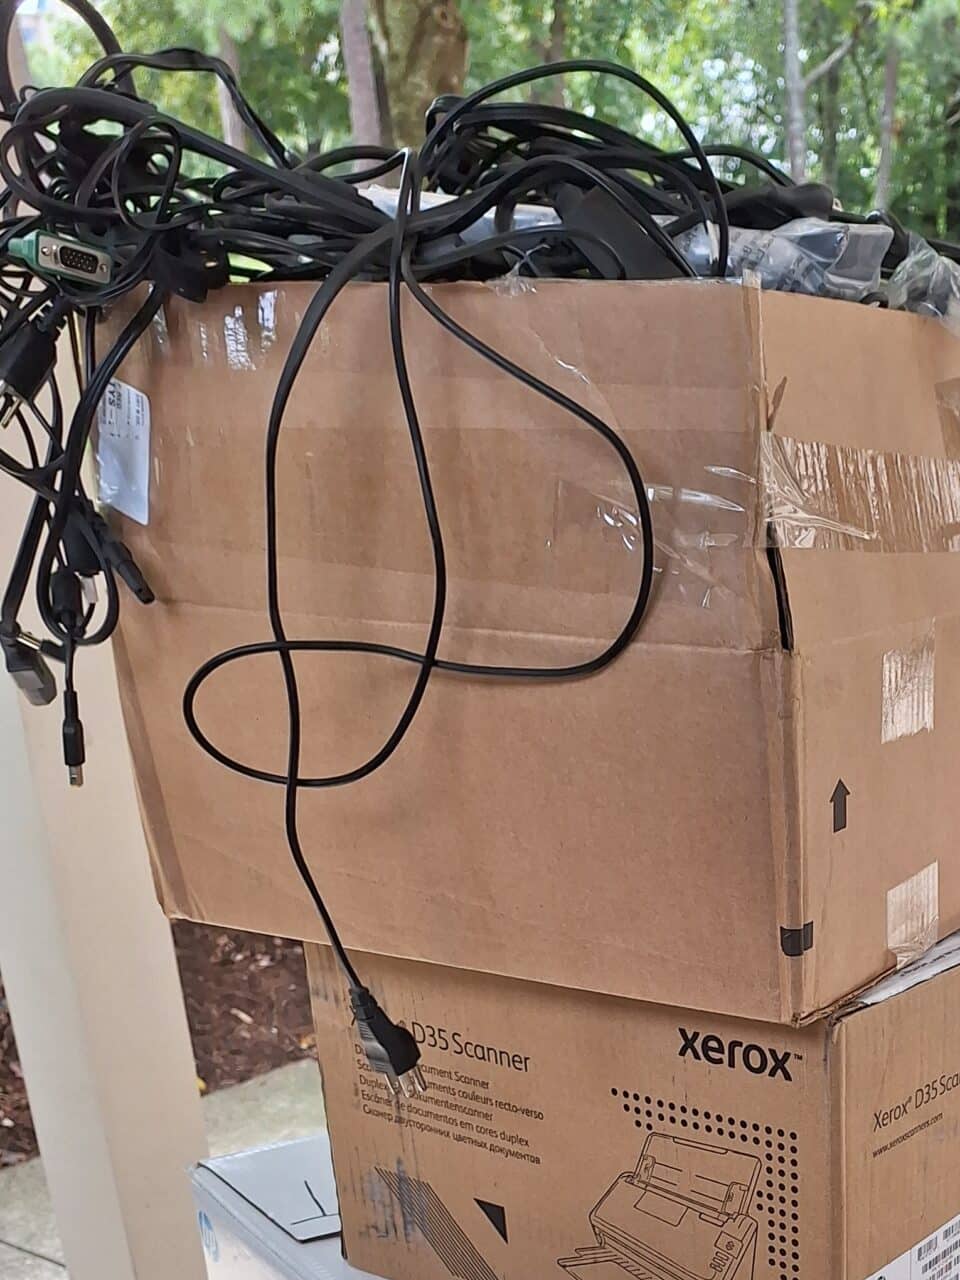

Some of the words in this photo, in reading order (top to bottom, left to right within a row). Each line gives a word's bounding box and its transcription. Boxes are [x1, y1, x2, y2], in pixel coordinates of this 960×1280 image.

[412, 1022, 449, 1051] D35
[451, 1033, 531, 1073] Scanner
[454, 1071, 490, 1090] Scanner
[914, 1079, 938, 1109] D35
[458, 1089, 494, 1107] couleurs
[495, 1099, 544, 1121] recto-verso
[407, 1103, 458, 1127] documentos
[475, 1124, 498, 1140] cores
[500, 1128, 530, 1148] duplex
